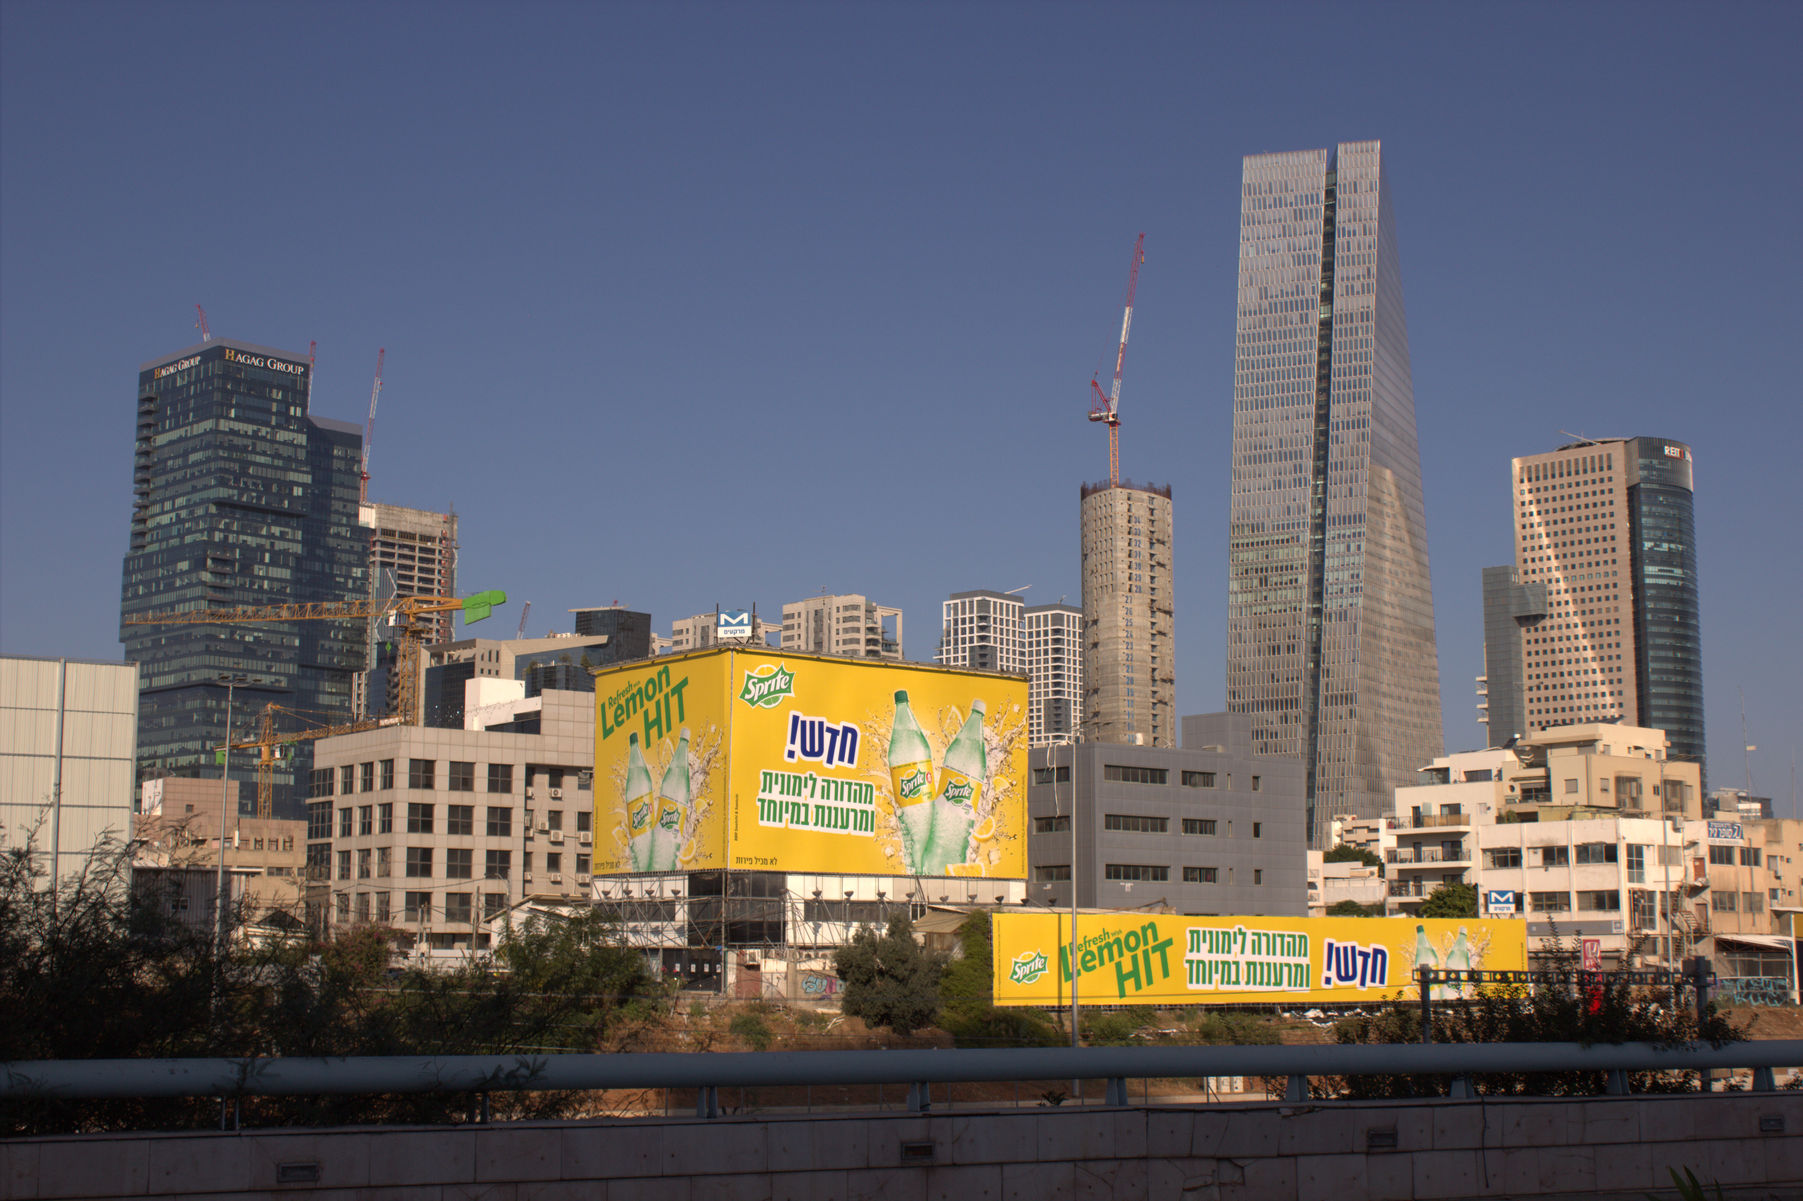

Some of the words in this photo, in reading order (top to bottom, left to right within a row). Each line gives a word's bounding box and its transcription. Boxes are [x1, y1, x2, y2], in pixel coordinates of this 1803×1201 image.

[154, 363, 177, 380] HAGAG
[178, 356, 201, 372] GROUP
[225, 348, 264, 368] HAGAG
[267, 358, 304, 375] GROUP
[608, 680, 633, 709] Refresh
[744, 670, 790, 702] Sprite
[601, 665, 671, 740] Lemon
[643, 676, 688, 749] HIT
[787, 714, 858, 765] חדש!
[761, 771, 818, 799] לימונית
[821, 778, 874, 805] מהדורה
[902, 771, 924, 796] Sprite
[945, 783, 972, 799] Sprite
[757, 798, 810, 826] במיוחד
[813, 804, 875, 833] ומרעננת
[770, 857, 778, 866] לא
[1060, 921, 1159, 983] Lemon
[1188, 927, 1247, 955] לימונית
[1251, 931, 1308, 957] מהדורה
[1013, 955, 1045, 981] Sprite
[1115, 937, 1173, 999] HIT
[1185, 959, 1241, 985] במיוחד
[1245, 961, 1310, 988] ומרעננת
[1324, 941, 1387, 987] חדש!
